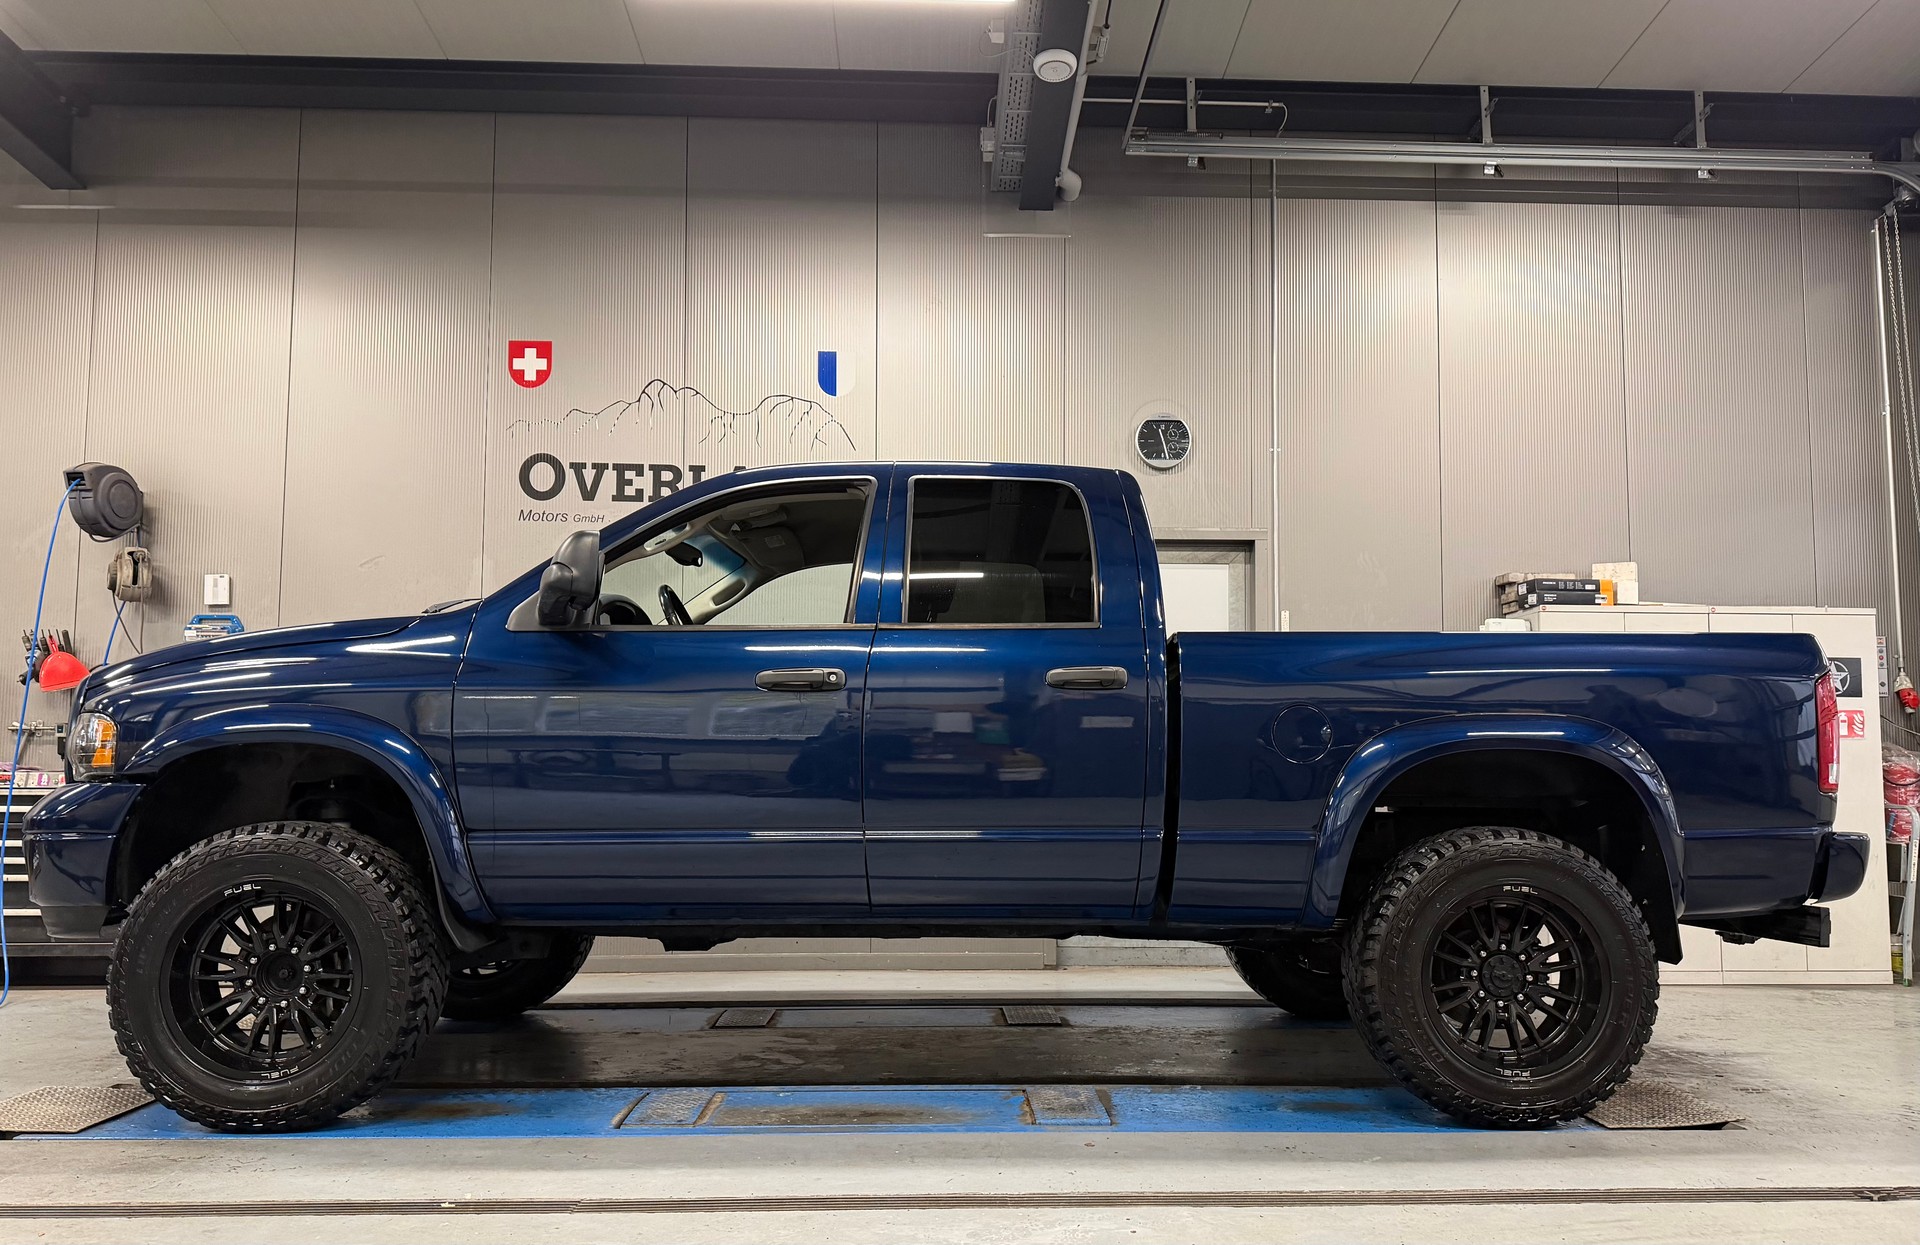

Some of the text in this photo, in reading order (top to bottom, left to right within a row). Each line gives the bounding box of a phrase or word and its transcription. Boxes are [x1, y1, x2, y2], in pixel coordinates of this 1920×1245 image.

[518, 509, 605, 523] Motors GmbH
[224, 883, 262, 897] FUEL
[1502, 885, 1538, 895] FUEL
[261, 1066, 299, 1079] FUEL
[1495, 1067, 1531, 1077] FUEL
